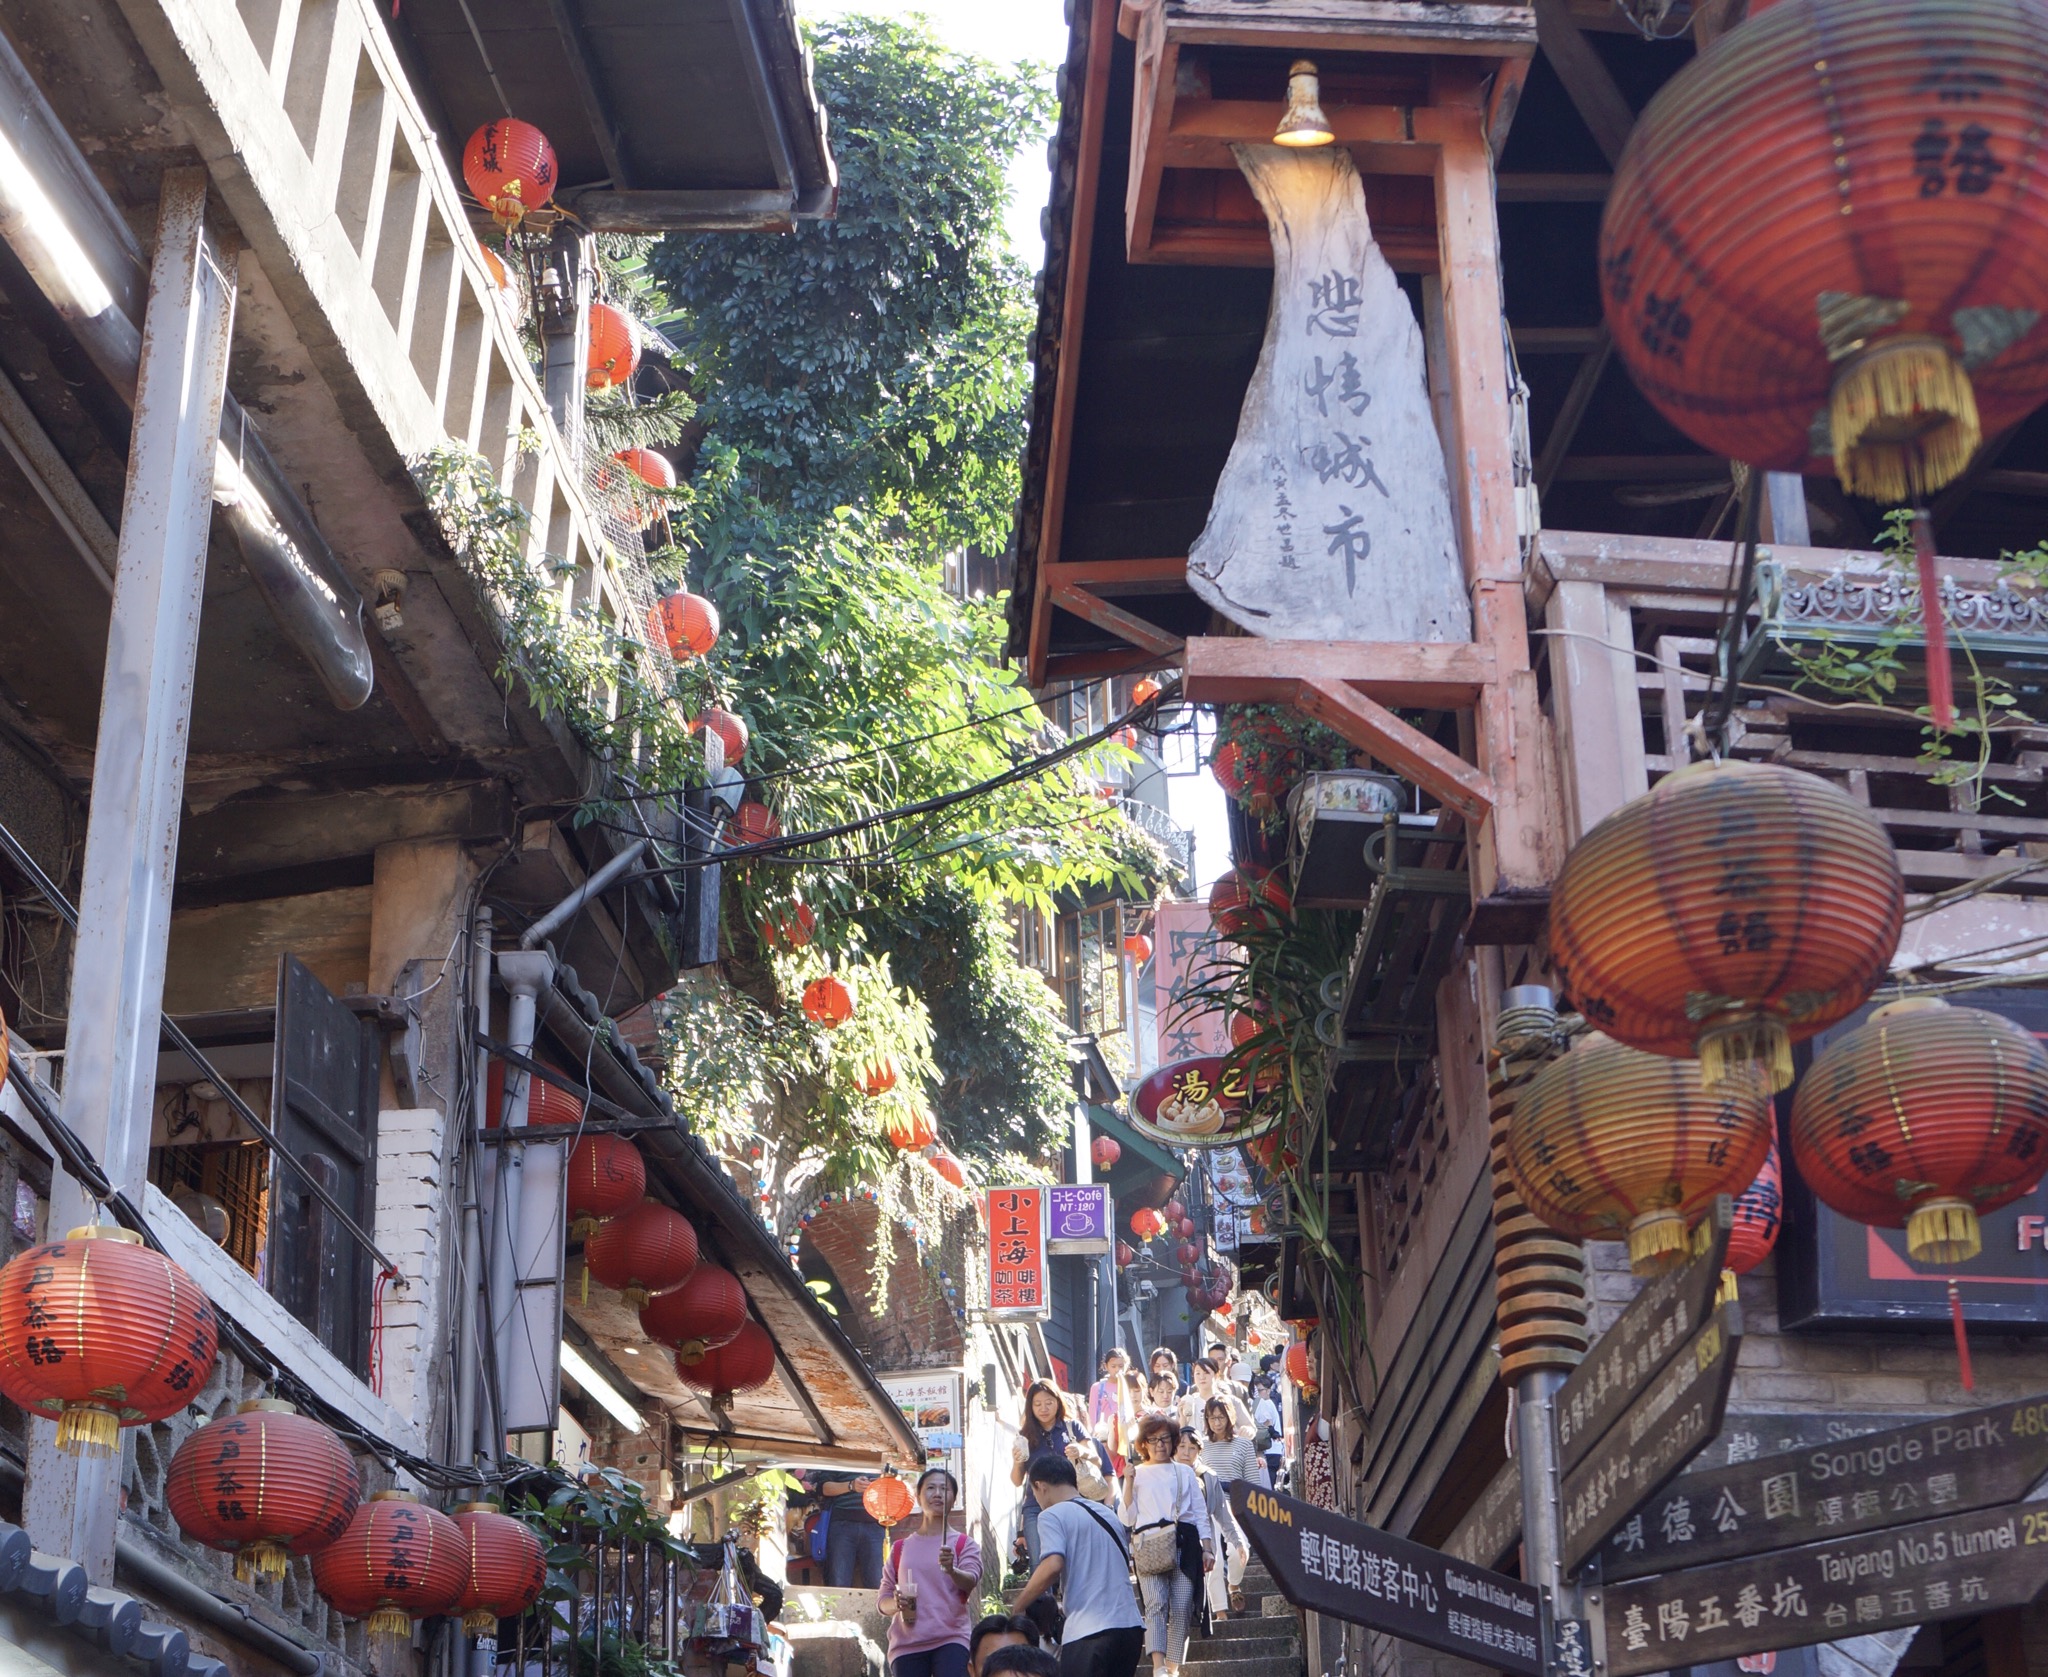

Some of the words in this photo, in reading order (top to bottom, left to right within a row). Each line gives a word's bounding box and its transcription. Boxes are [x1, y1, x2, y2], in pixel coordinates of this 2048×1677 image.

[1304, 269, 1390, 599] 悲情城市
[998, 1192, 1035, 1266] 小上海
[994, 1288, 1036, 1304] 茶樓
[995, 1269, 1036, 1285] 咖啡
[1811, 1435, 1924, 1481] Songde
[1931, 1416, 2004, 1456] Park
[1299, 1527, 1439, 1614] 輕便路遊客中心
[1816, 1549, 1895, 1586] Taiyang
[1899, 1535, 1948, 1568] No.5
[1952, 1518, 2018, 1559] tunnel
[1621, 1575, 1809, 1652] 臺陽五番坑
[1823, 1576, 1989, 1629] 台陽五番坑
